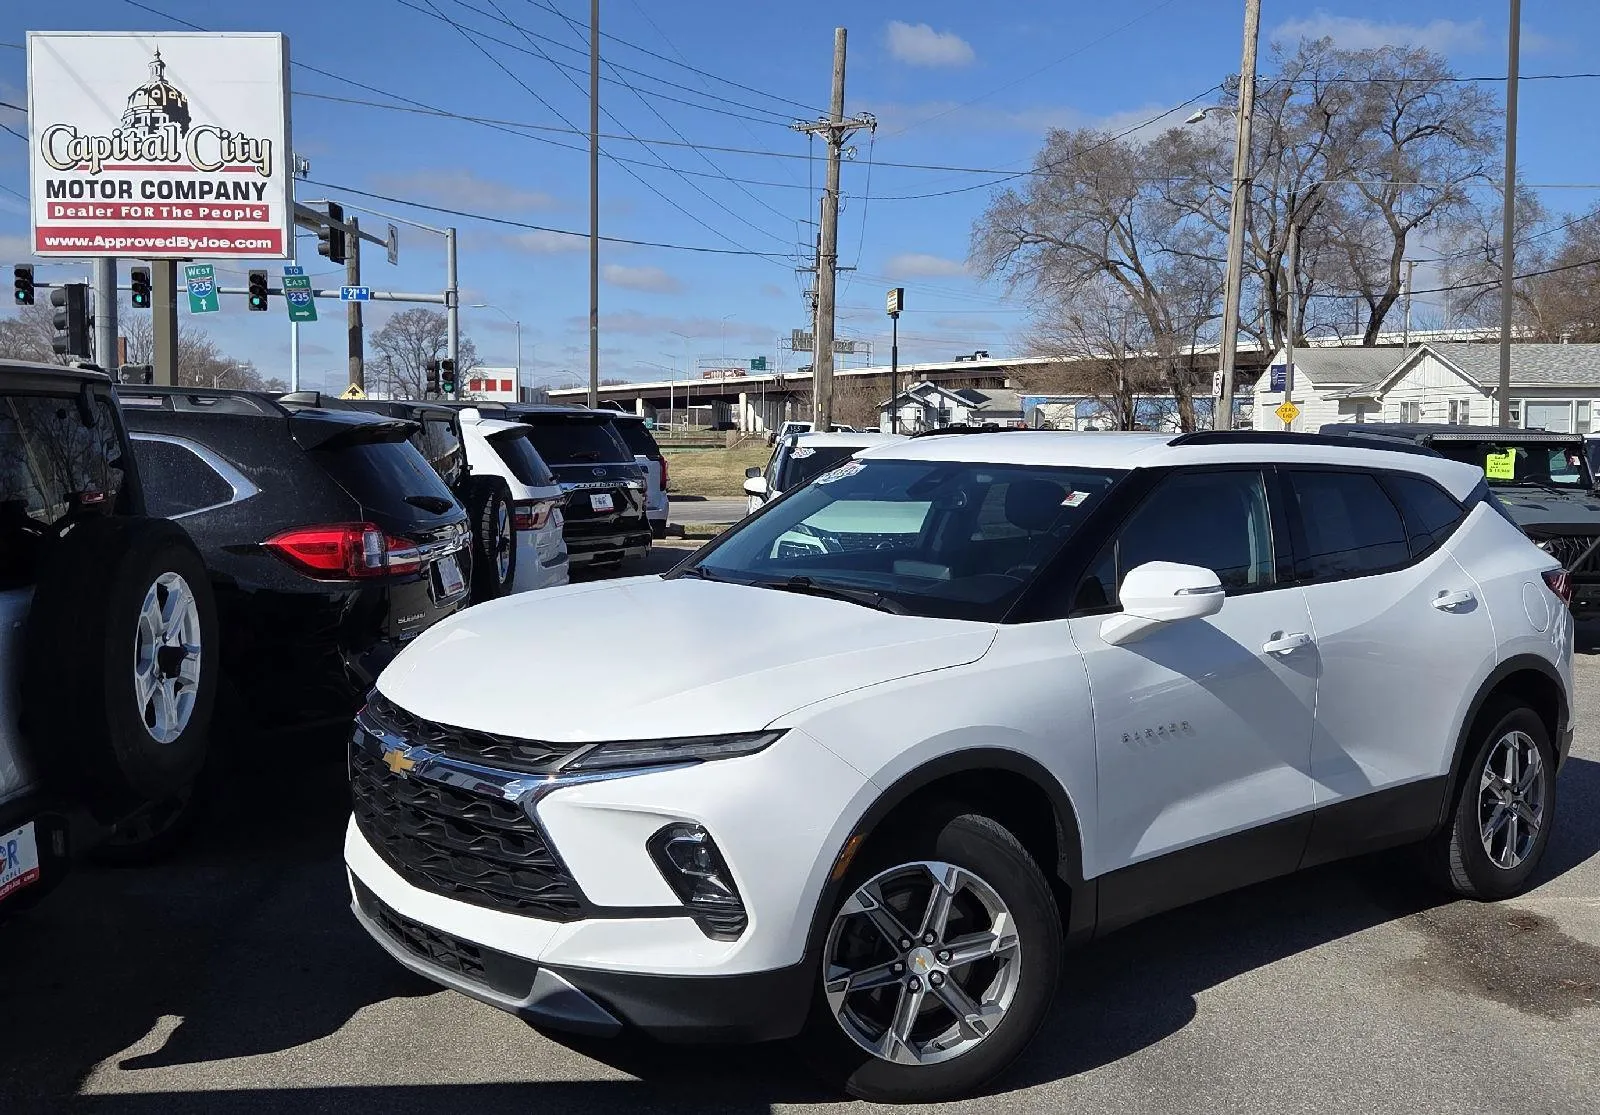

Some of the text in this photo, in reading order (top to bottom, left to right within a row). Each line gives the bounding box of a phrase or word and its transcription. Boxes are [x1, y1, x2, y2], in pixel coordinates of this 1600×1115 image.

[41, 123, 273, 178] Capital City
[46, 179, 268, 202] MOTOR COMPANY
[54, 205, 263, 220] Dealer FOR The People
[44, 235, 272, 250] www.ApprovedByJoe.com
[192, 281, 213, 293] 235
[290, 292, 310, 302] 235
